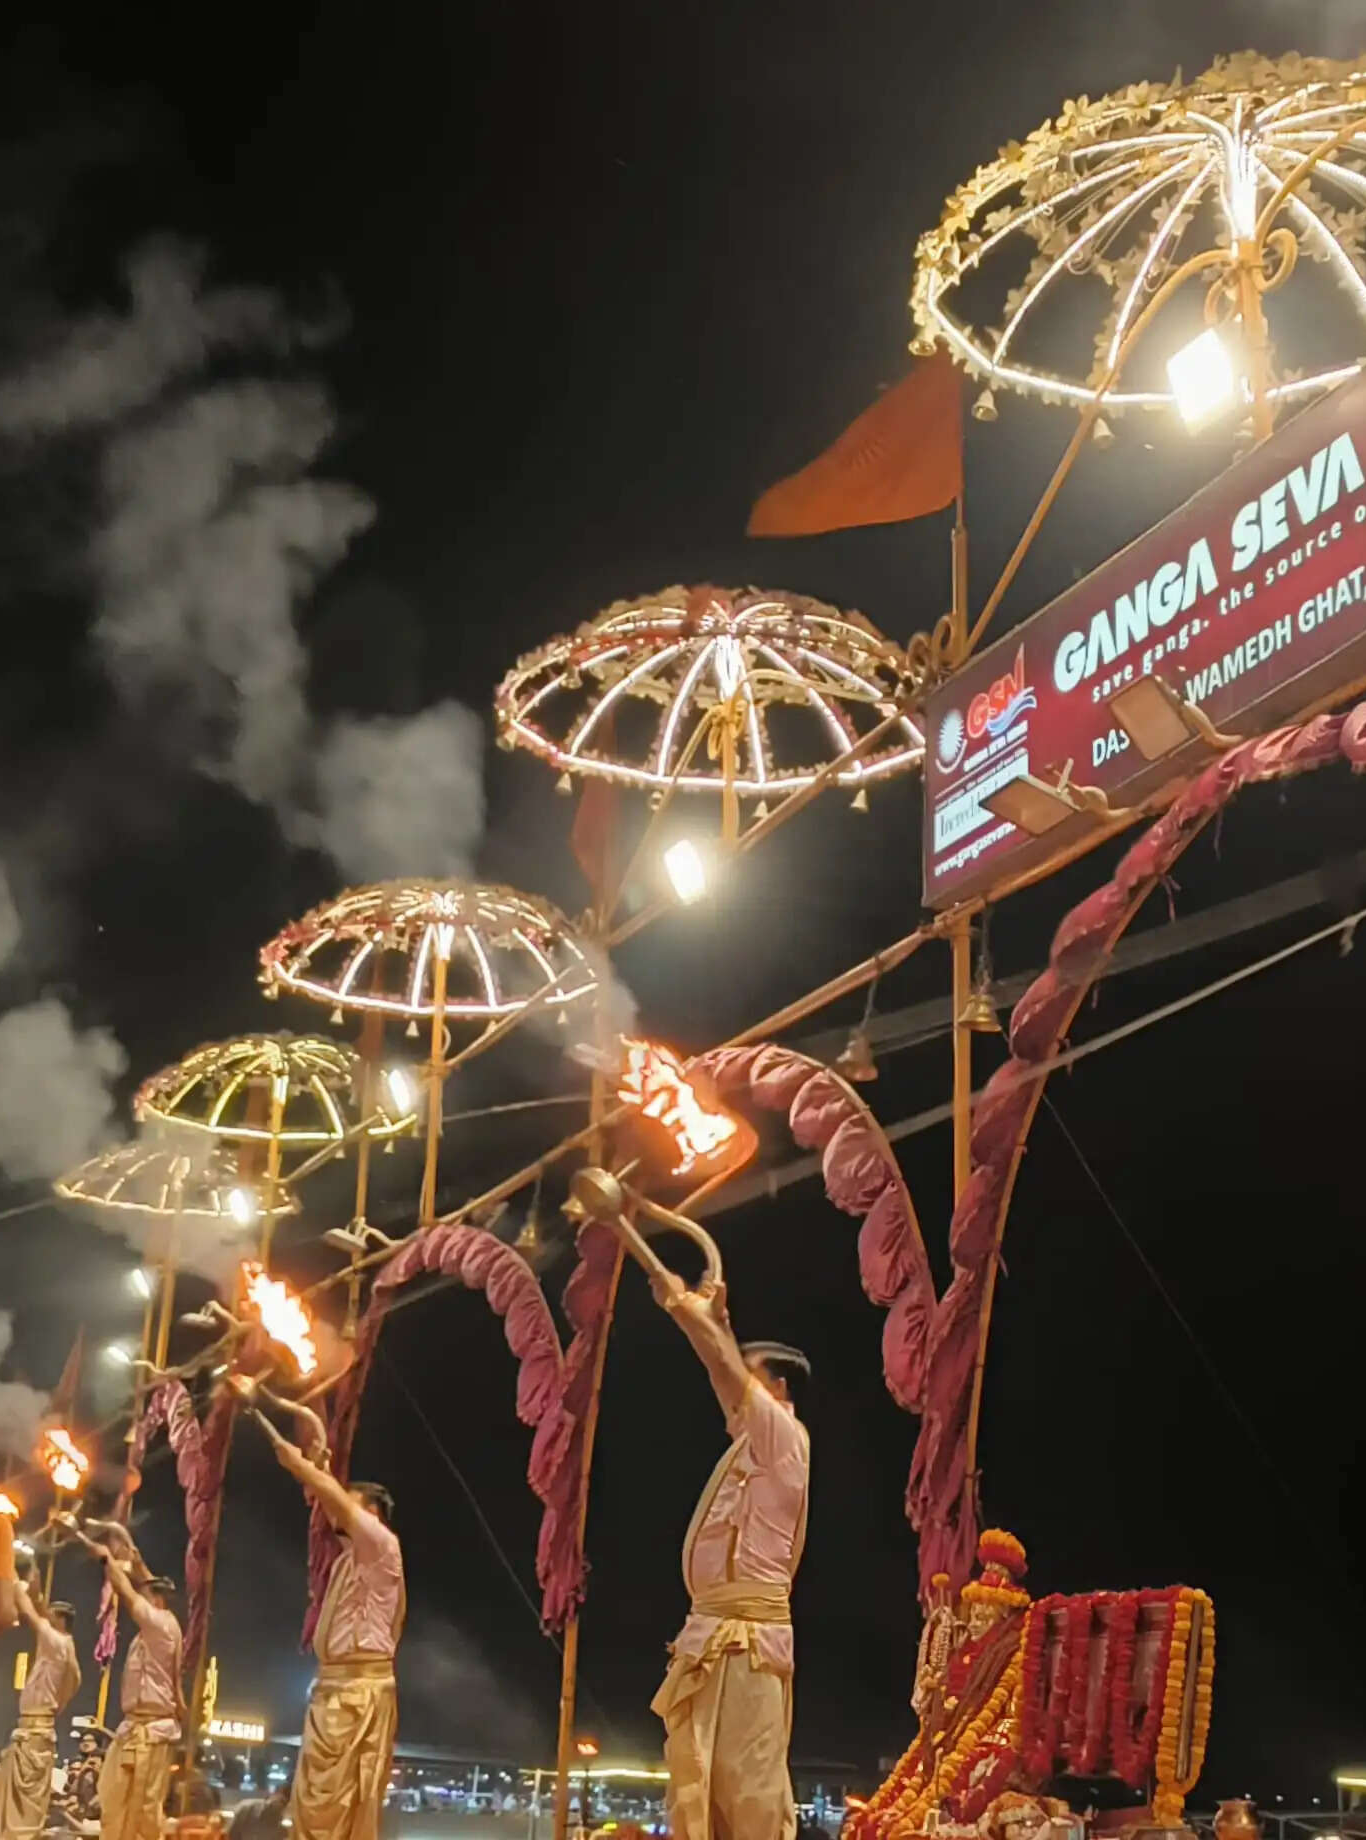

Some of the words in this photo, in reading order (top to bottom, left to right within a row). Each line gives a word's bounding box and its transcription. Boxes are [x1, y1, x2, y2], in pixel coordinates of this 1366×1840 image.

[1053, 537, 1218, 692] GANGA
[1231, 432, 1364, 571] SEVA
[1093, 669, 1134, 702] save
[1218, 581, 1254, 616] the
[1264, 521, 1342, 585] source
